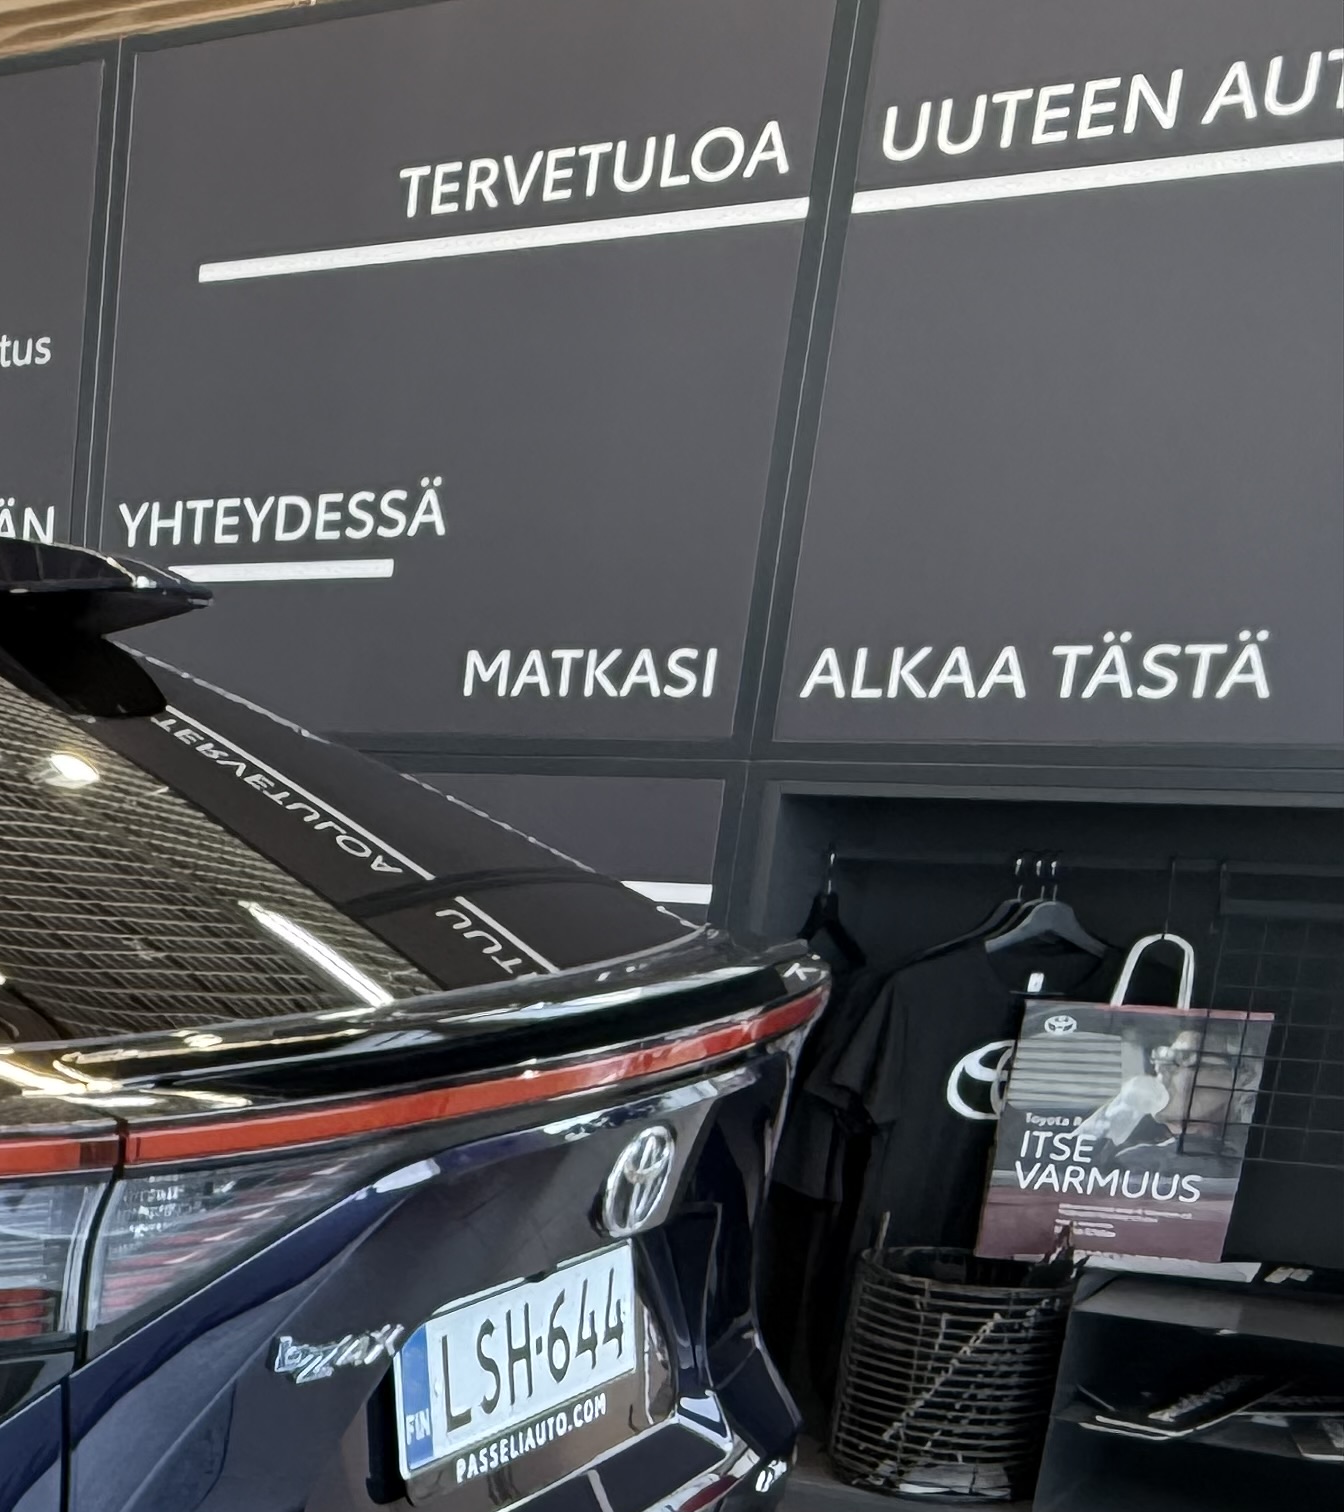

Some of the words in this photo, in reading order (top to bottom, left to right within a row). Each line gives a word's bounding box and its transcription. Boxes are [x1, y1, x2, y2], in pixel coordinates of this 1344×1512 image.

[399, 119, 790, 219] TERVETULOA
[881, 68, 1184, 162] UUTEEN
[118, 476, 446, 547] YHTEYDESSÄ
[463, 647, 718, 698] MATKASI
[799, 645, 1027, 700] ALKAA
[1052, 630, 1272, 700] TÄSTÄ
[1015, 1160, 1203, 1203] VARMUUS
[1020, 1130, 1097, 1163] ITSE
[405, 1408, 431, 1446] FIN
[441, 1267, 624, 1434] LSH-644
[455, 1392, 607, 1485] PASSELIAUTO.COM
